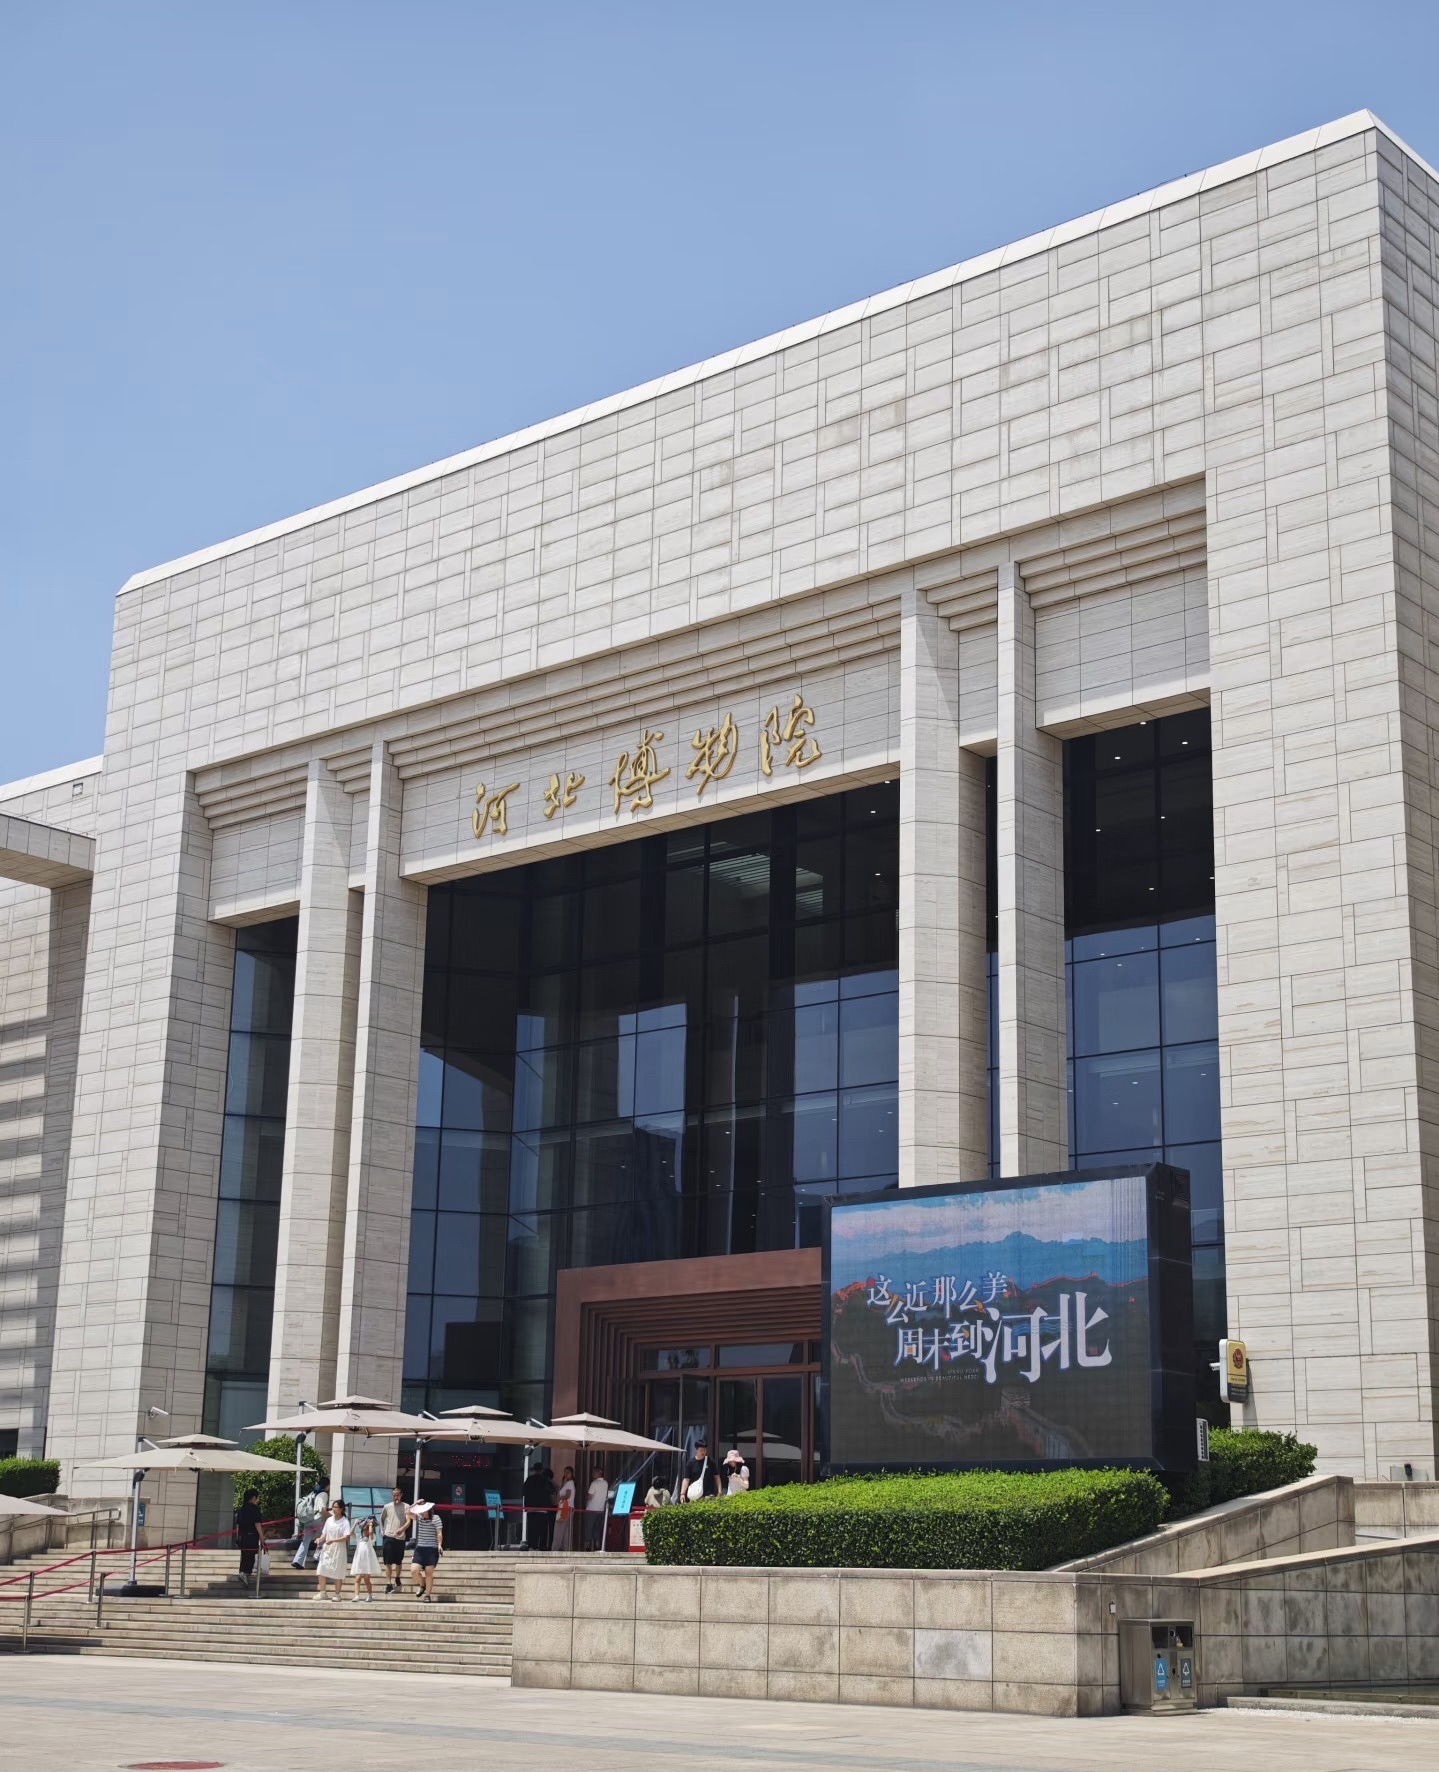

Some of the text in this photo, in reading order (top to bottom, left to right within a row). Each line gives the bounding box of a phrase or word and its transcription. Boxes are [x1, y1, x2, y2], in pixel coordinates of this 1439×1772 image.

[474, 694, 822, 838] 河北博物院
[867, 1271, 1008, 1324] 这么近那么美
[895, 1291, 1112, 1383] 周末到河北
